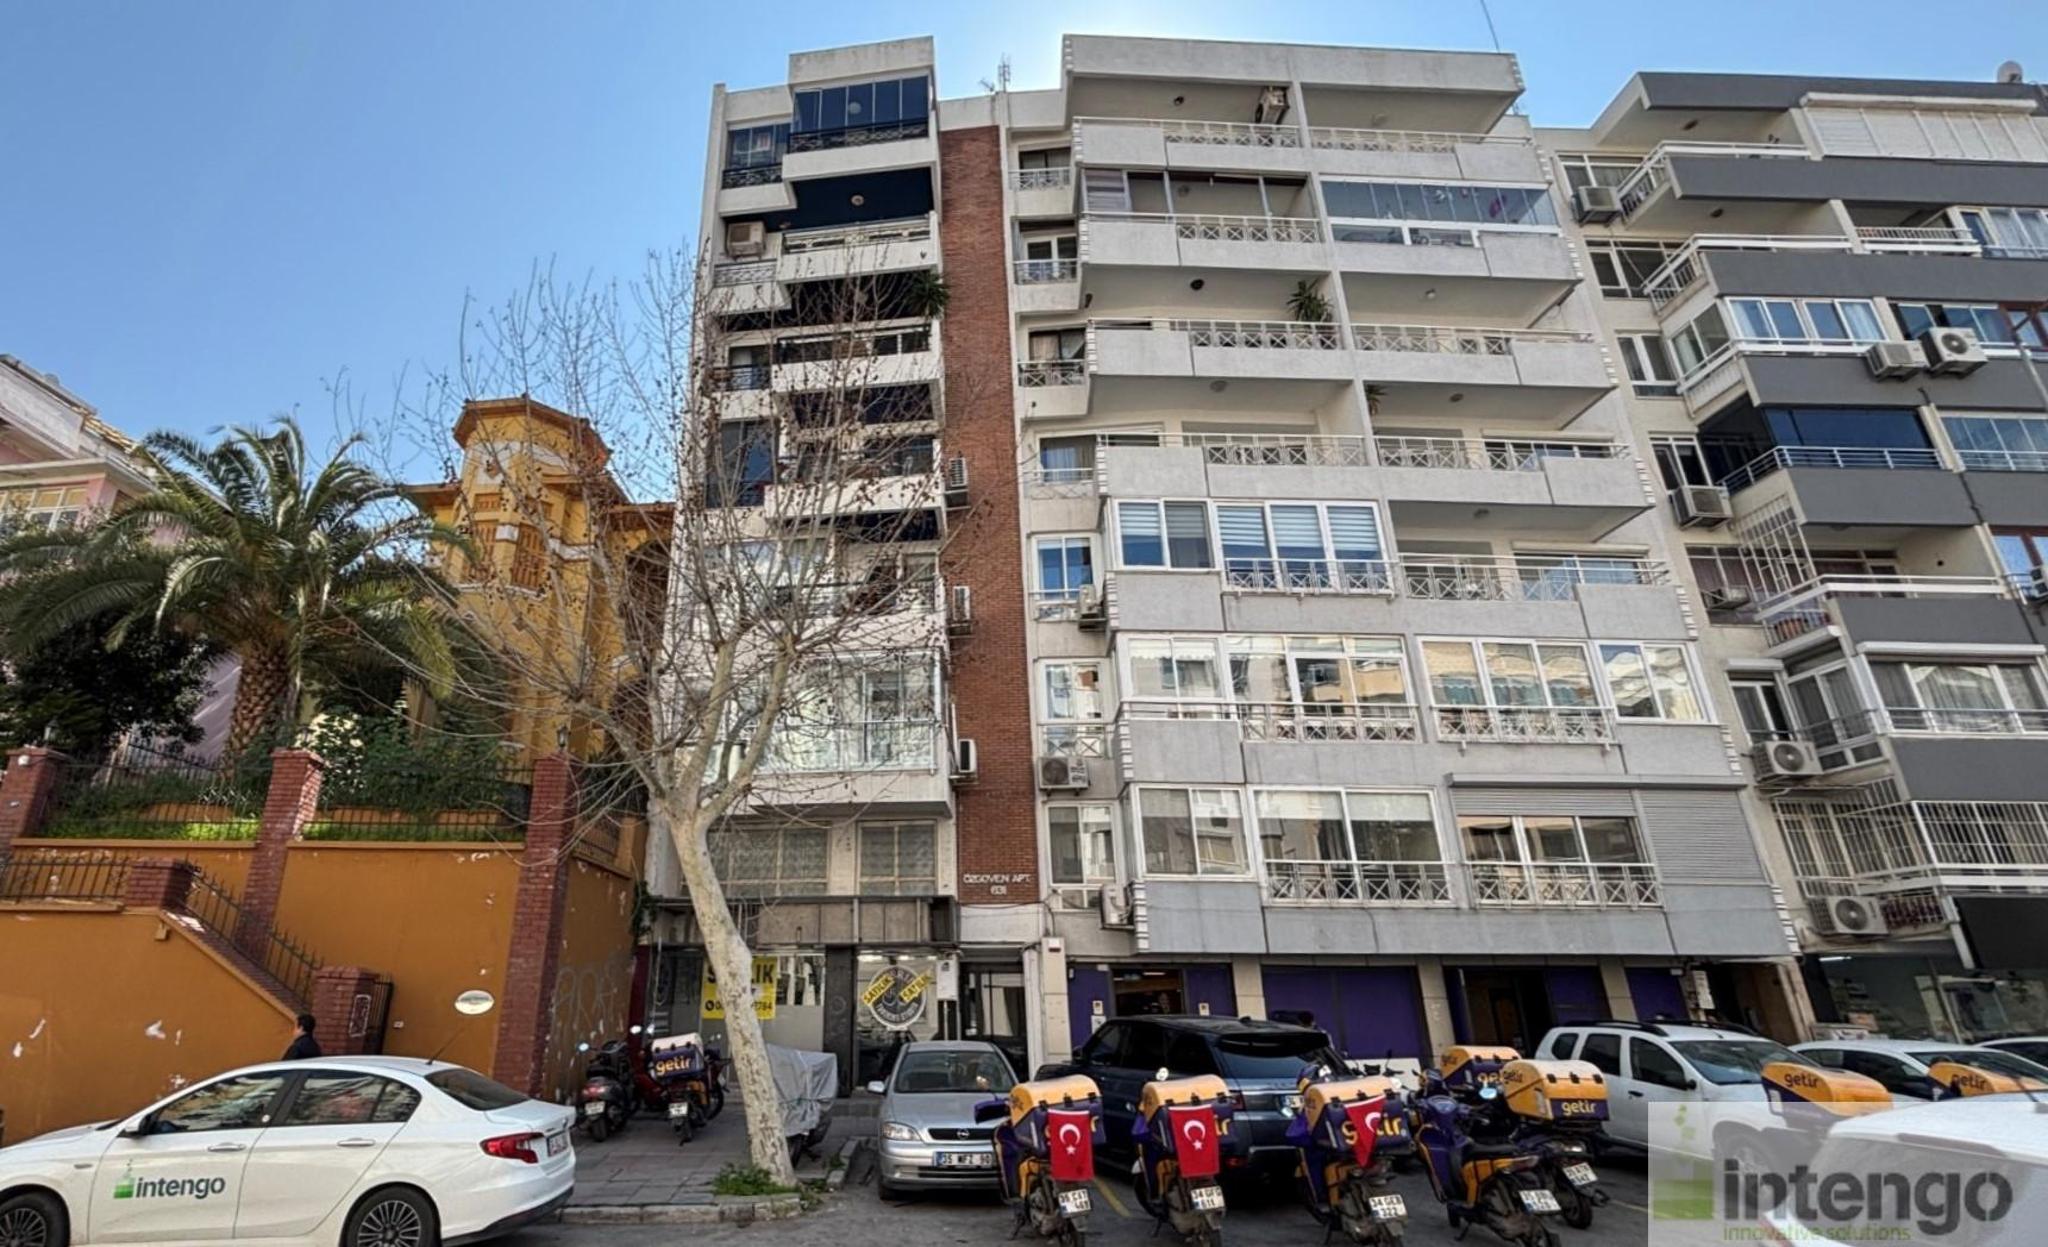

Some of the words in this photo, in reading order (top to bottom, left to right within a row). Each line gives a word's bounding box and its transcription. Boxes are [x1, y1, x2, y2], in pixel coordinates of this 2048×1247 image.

[656, 1056, 691, 1076] getir
[1784, 1072, 1818, 1088] getir
[1561, 1101, 1596, 1115] getir
[136, 1177, 226, 1199] intengo
